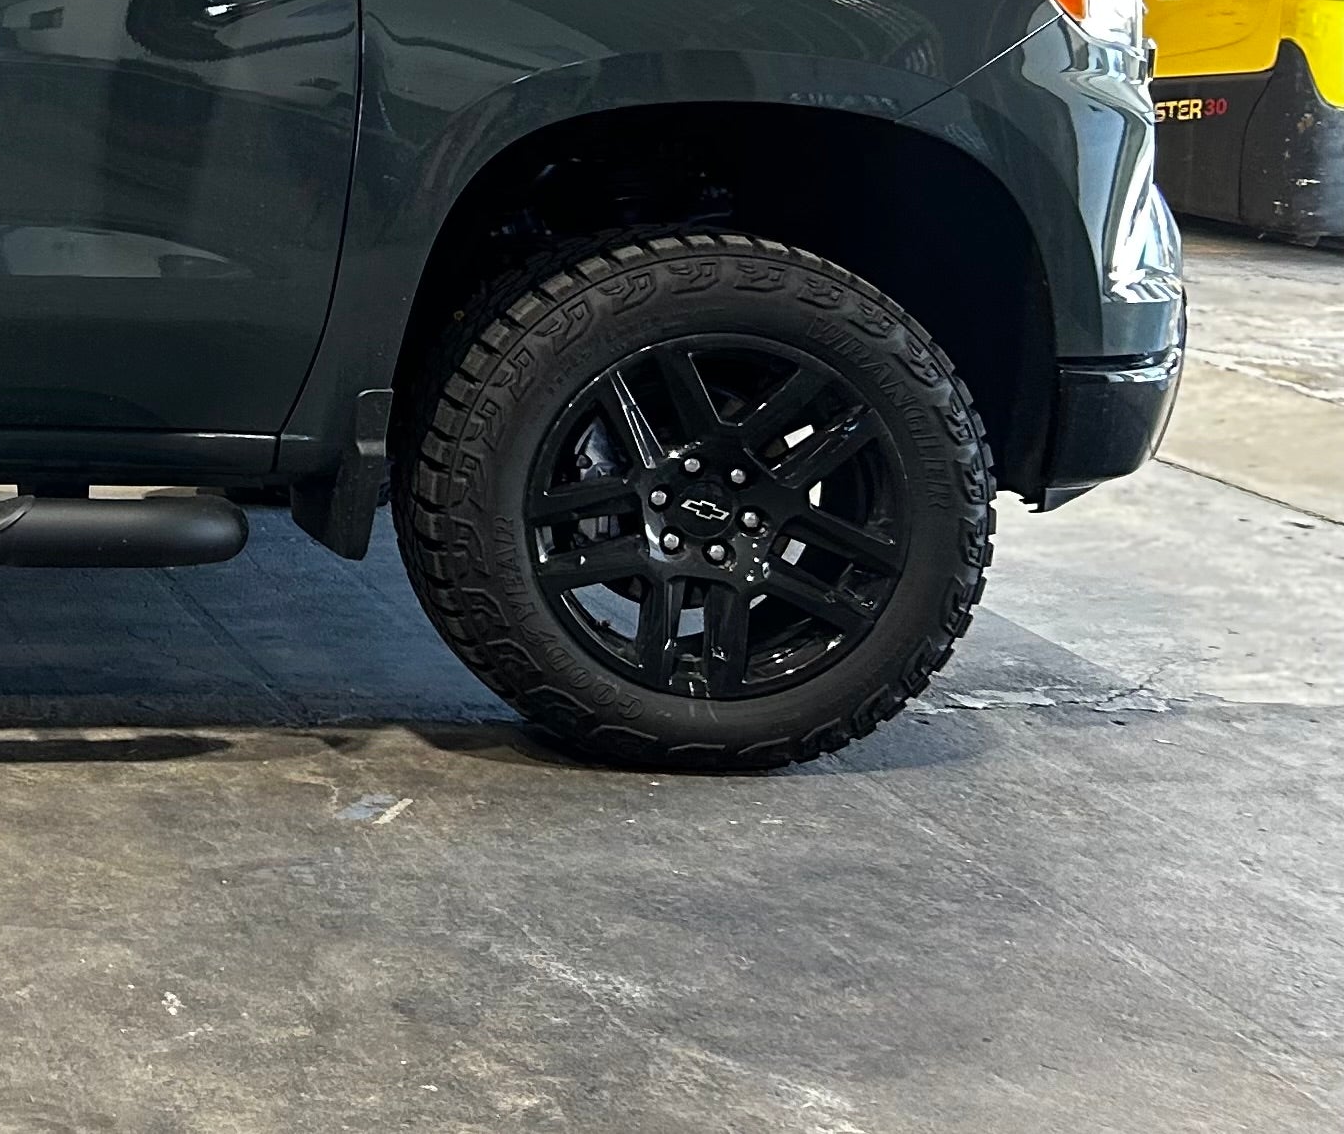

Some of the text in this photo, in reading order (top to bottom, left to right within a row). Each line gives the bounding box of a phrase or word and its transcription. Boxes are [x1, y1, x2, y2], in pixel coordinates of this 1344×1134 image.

[1154, 97, 1229, 123] STER 30
[495, 516, 645, 721] GOODYEAR
